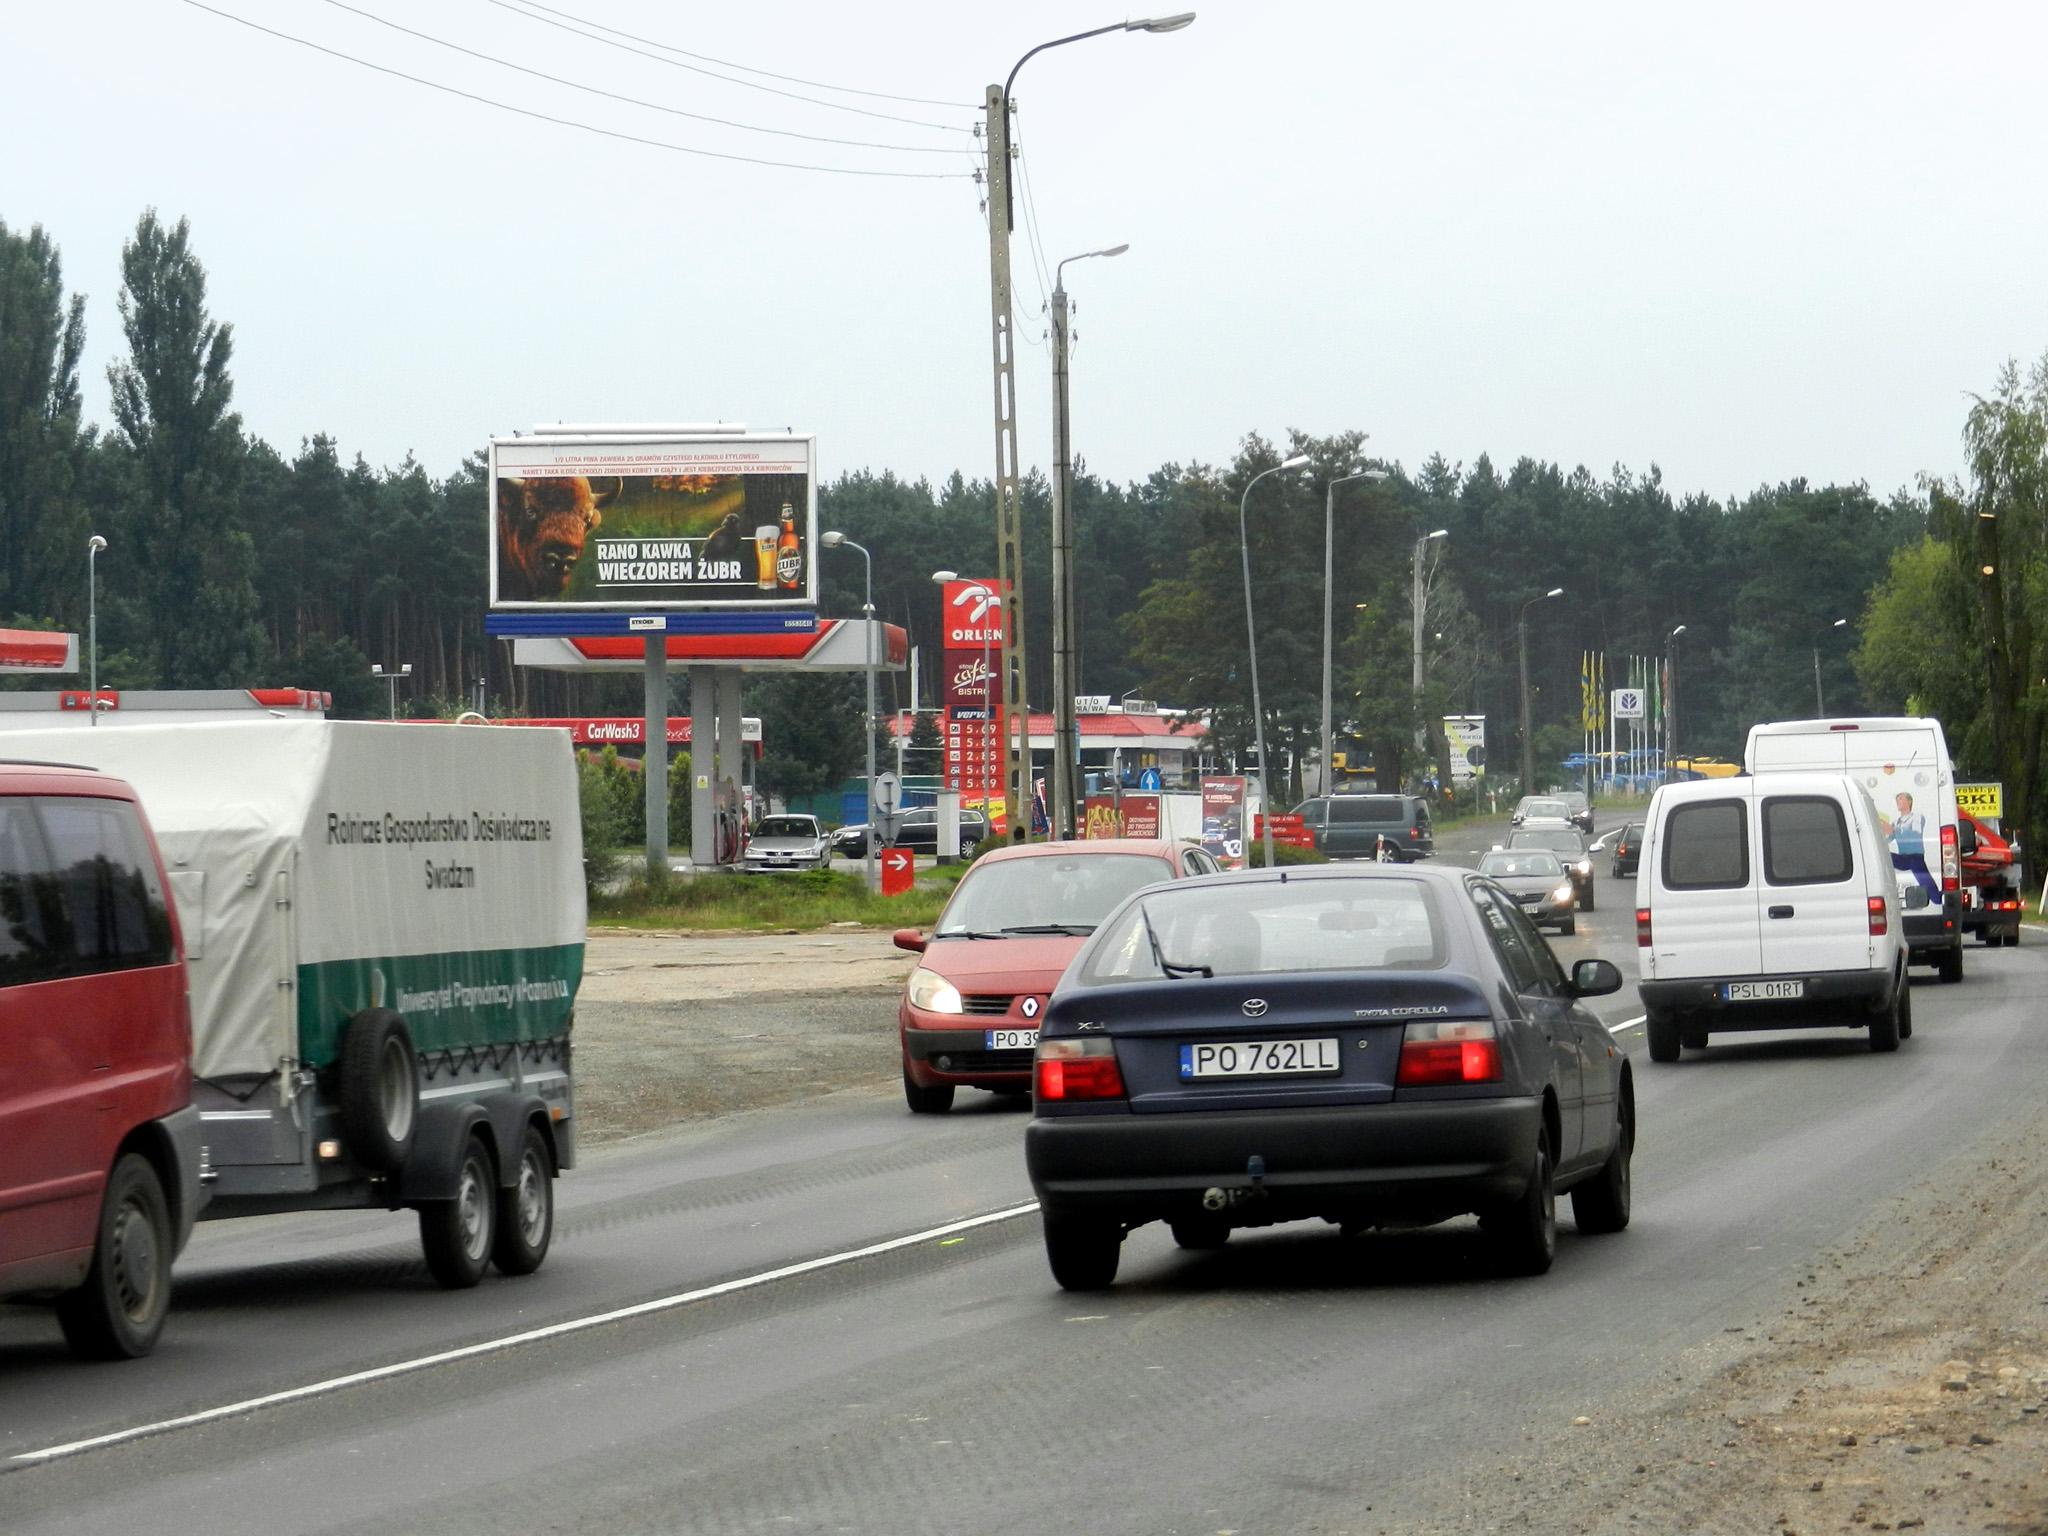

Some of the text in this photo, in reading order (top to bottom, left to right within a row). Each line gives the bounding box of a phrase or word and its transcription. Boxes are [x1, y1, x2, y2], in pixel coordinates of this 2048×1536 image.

[597, 543, 692, 560] RANO KAWKA
[598, 558, 742, 581] WIECZOREM ŻUBR
[952, 629, 1002, 641] ORLEN
[588, 723, 640, 740] CarWash3
[1956, 794, 1997, 804] BKI
[327, 811, 551, 851] Rolnicze Gospodarstwo Doświadczane
[424, 858, 475, 890] Swadzm
[1730, 982, 1801, 999] PSL 01RT
[1355, 1006, 1448, 1017] TOYOTA COROLLA
[996, 1032, 1018, 1047] PO
[1181, 1041, 1334, 1073] PL PO 762LL
